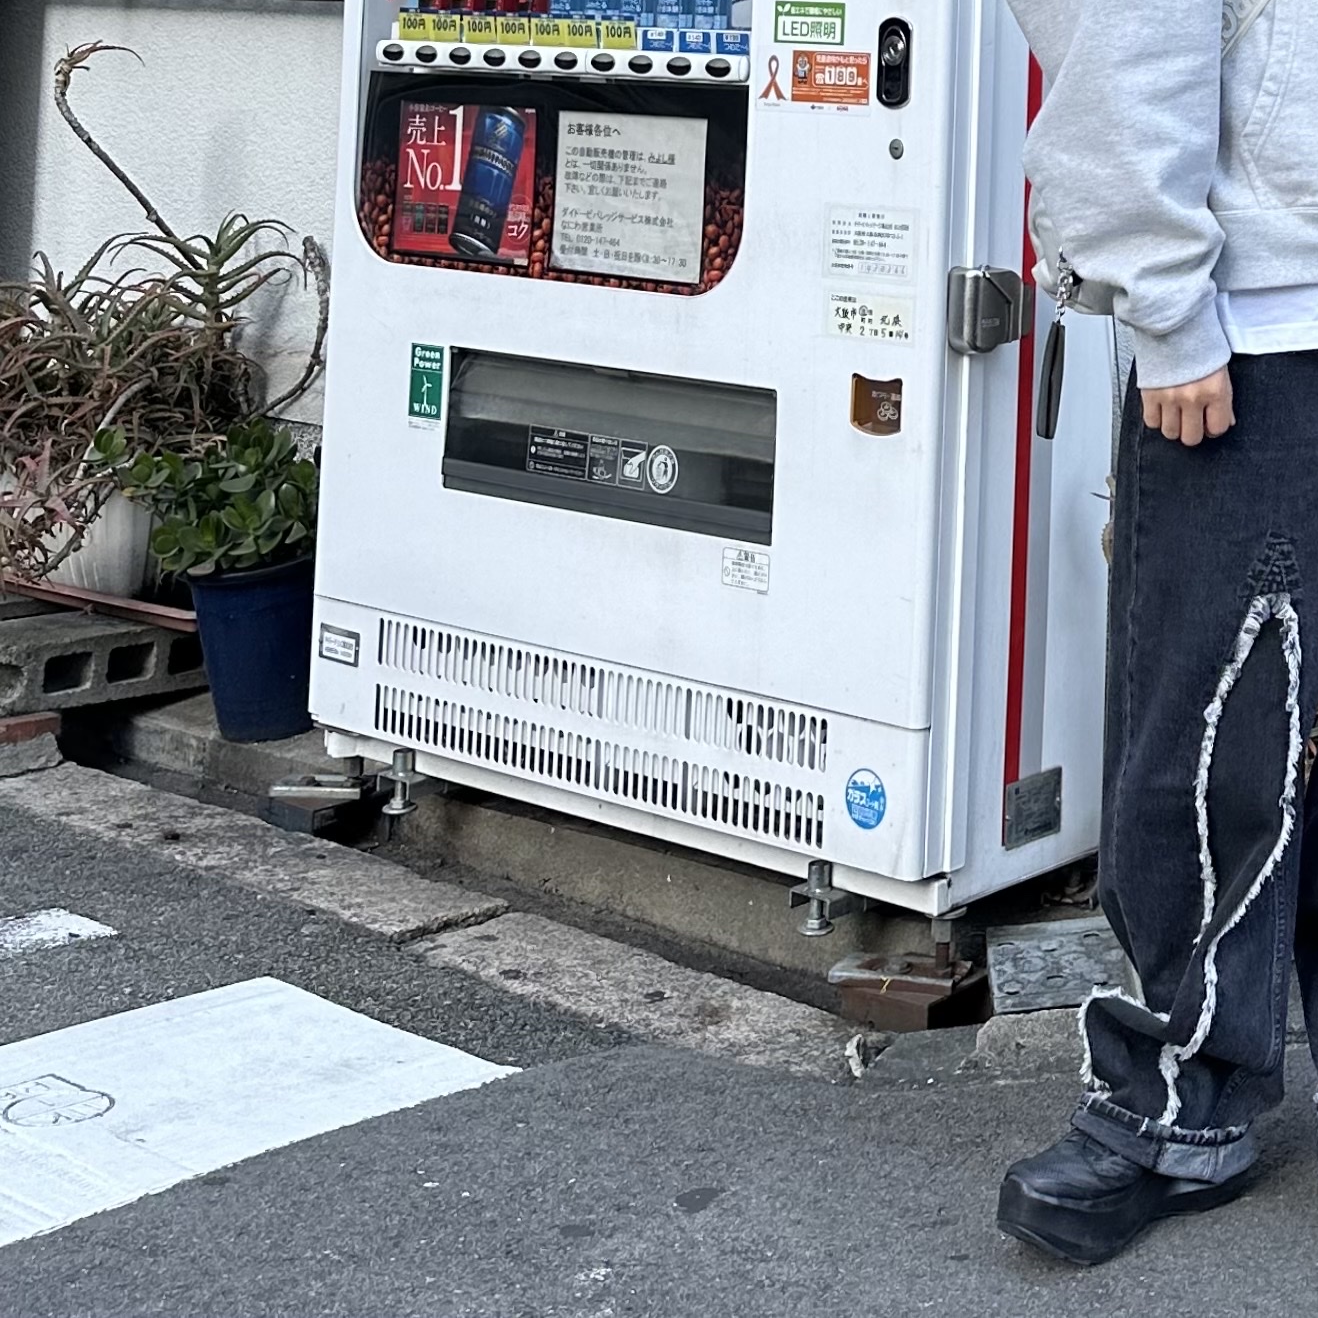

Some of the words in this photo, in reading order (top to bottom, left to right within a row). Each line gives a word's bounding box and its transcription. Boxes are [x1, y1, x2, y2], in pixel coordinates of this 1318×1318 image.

[402, 17, 426, 29] 100円
[432, 18, 457, 31] 100円
[467, 20, 492, 33] 100円
[500, 21, 525, 34] 100円
[535, 23, 560, 36] 100円
[567, 23, 593, 37] 100円
[605, 25, 632, 38] 100円
[782, 20, 836, 40] LED照明
[406, 114, 446, 146] 売上
[567, 123, 621, 137] お客様各位へ
[403, 105, 465, 191] No.1
[508, 221, 529, 240] コク
[414, 347, 441, 359] Green
[413, 357, 441, 370] Power
[413, 403, 438, 417] WIND
